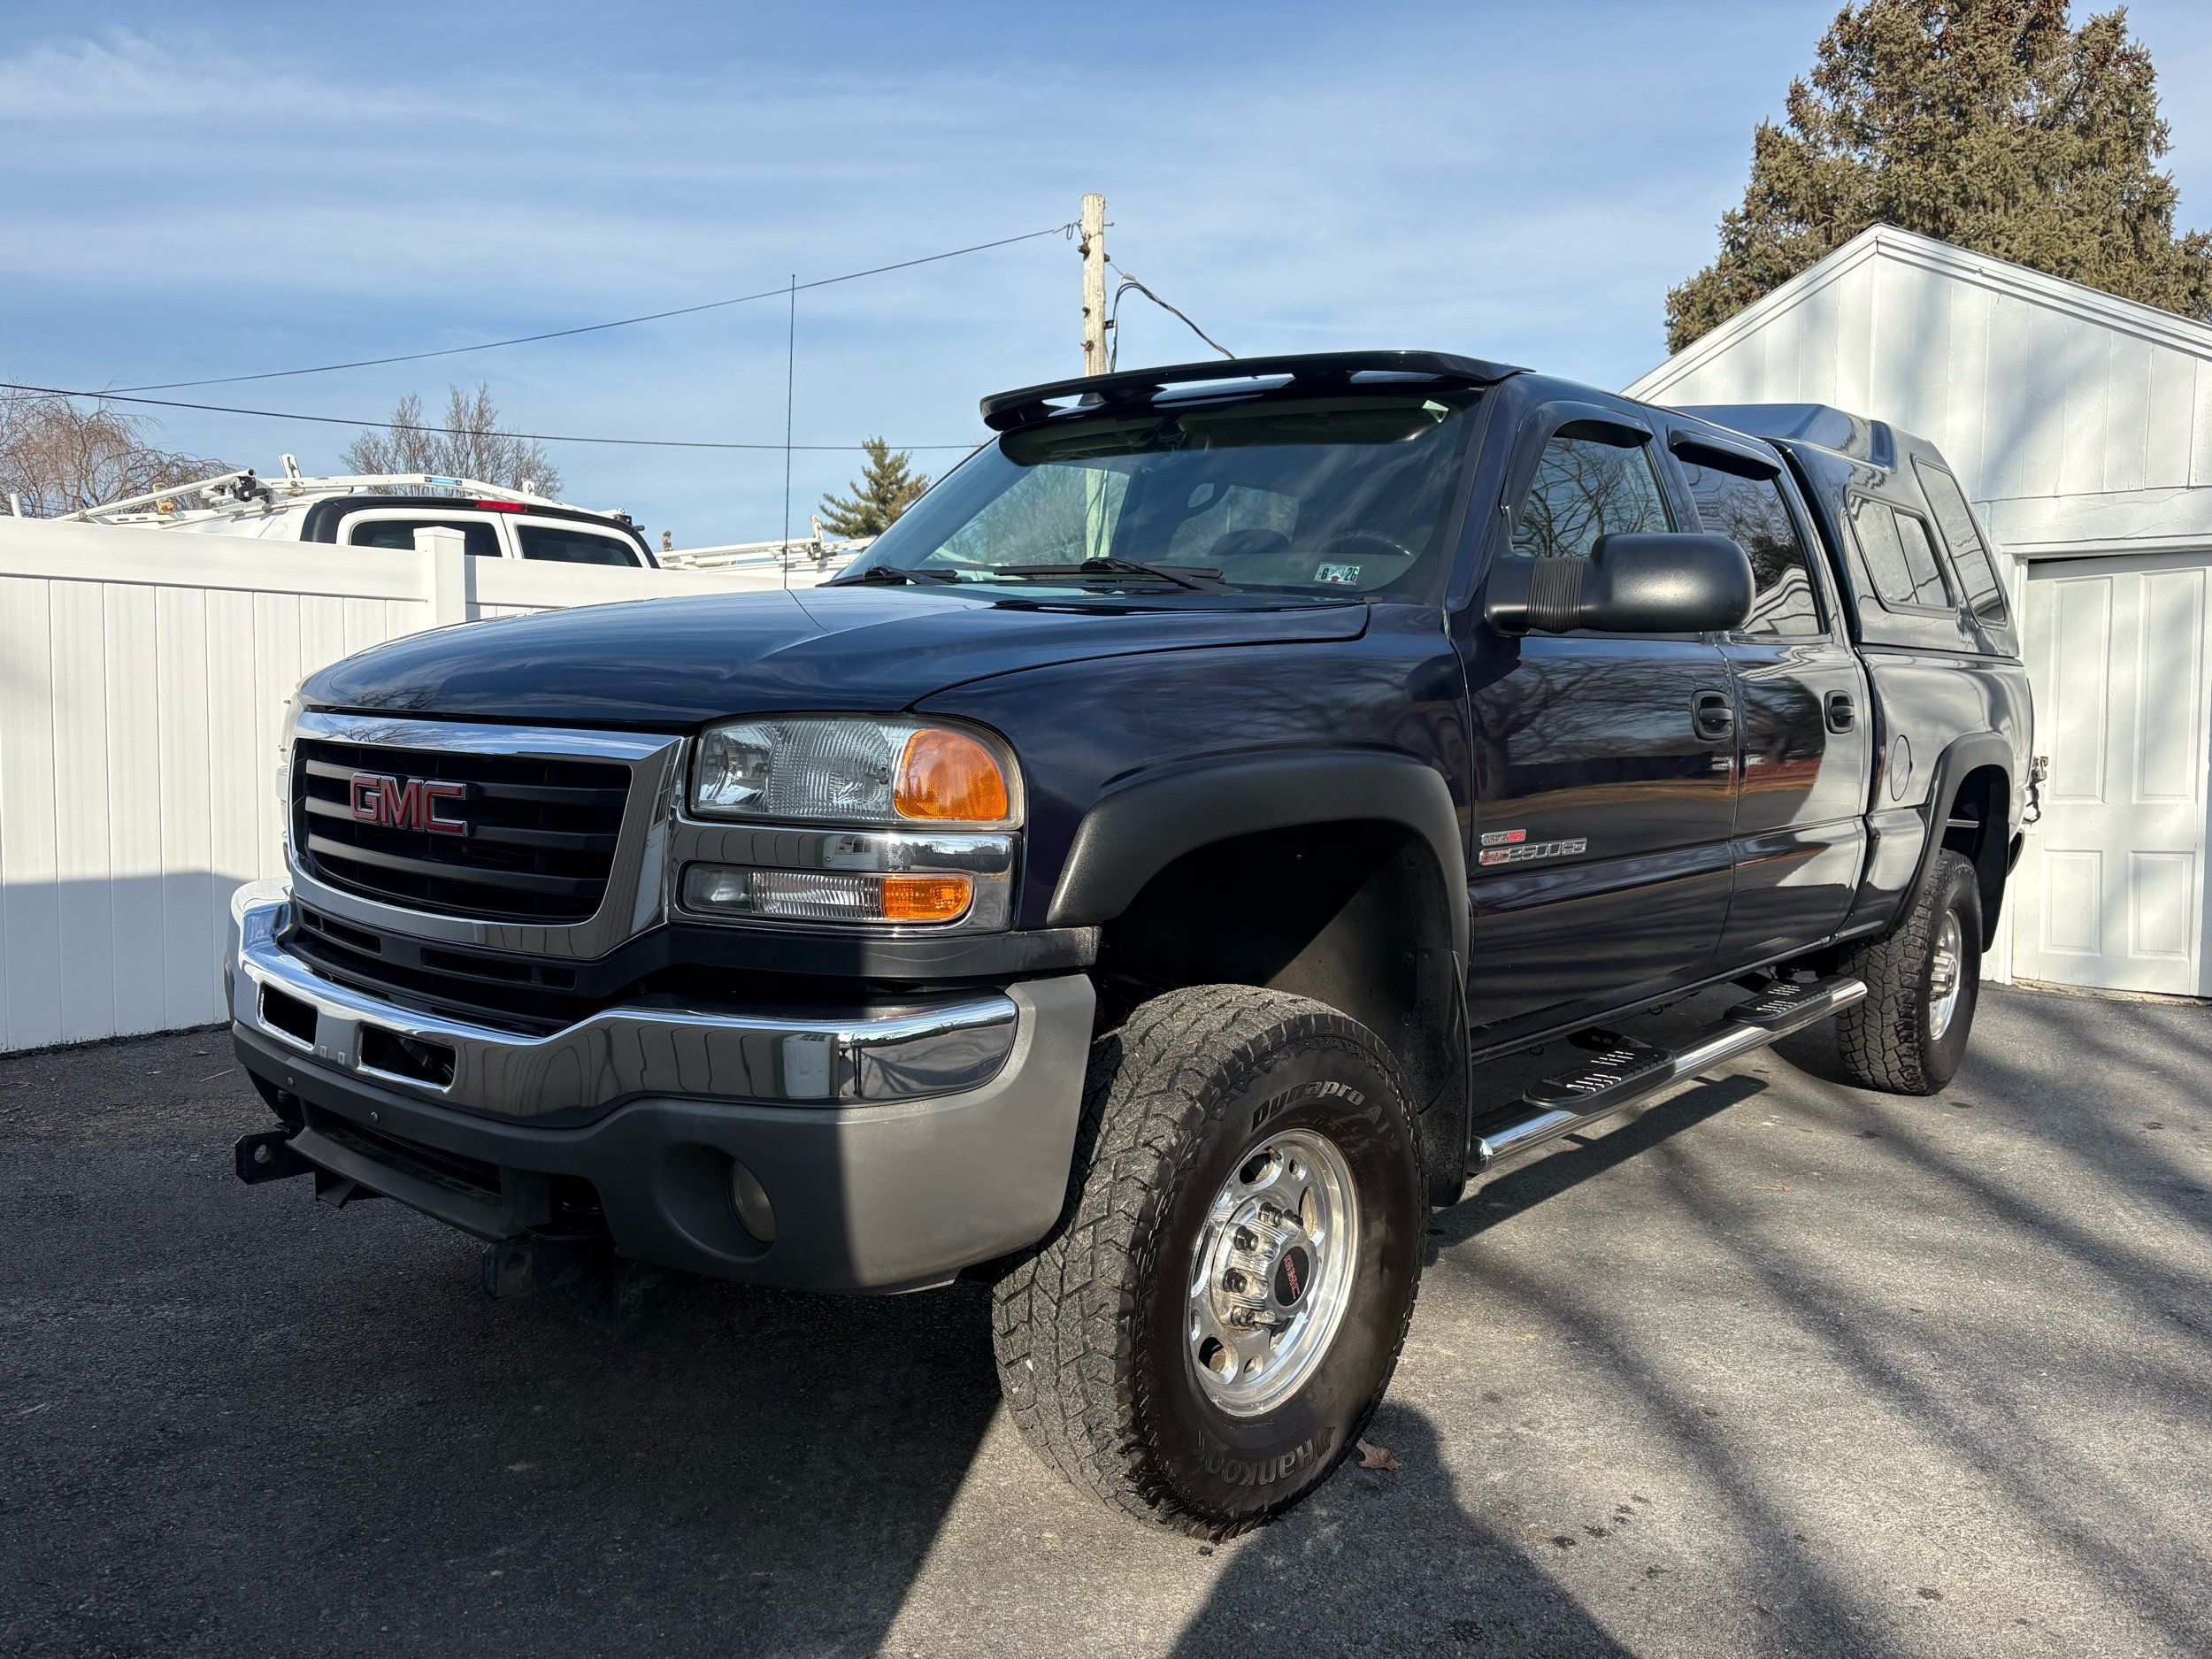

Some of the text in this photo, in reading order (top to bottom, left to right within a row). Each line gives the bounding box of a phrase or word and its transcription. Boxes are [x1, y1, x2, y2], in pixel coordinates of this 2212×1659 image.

[1344, 567, 1359, 581] 26
[350, 772, 468, 836] GMC
[1284, 1254, 1301, 1300] GMC
